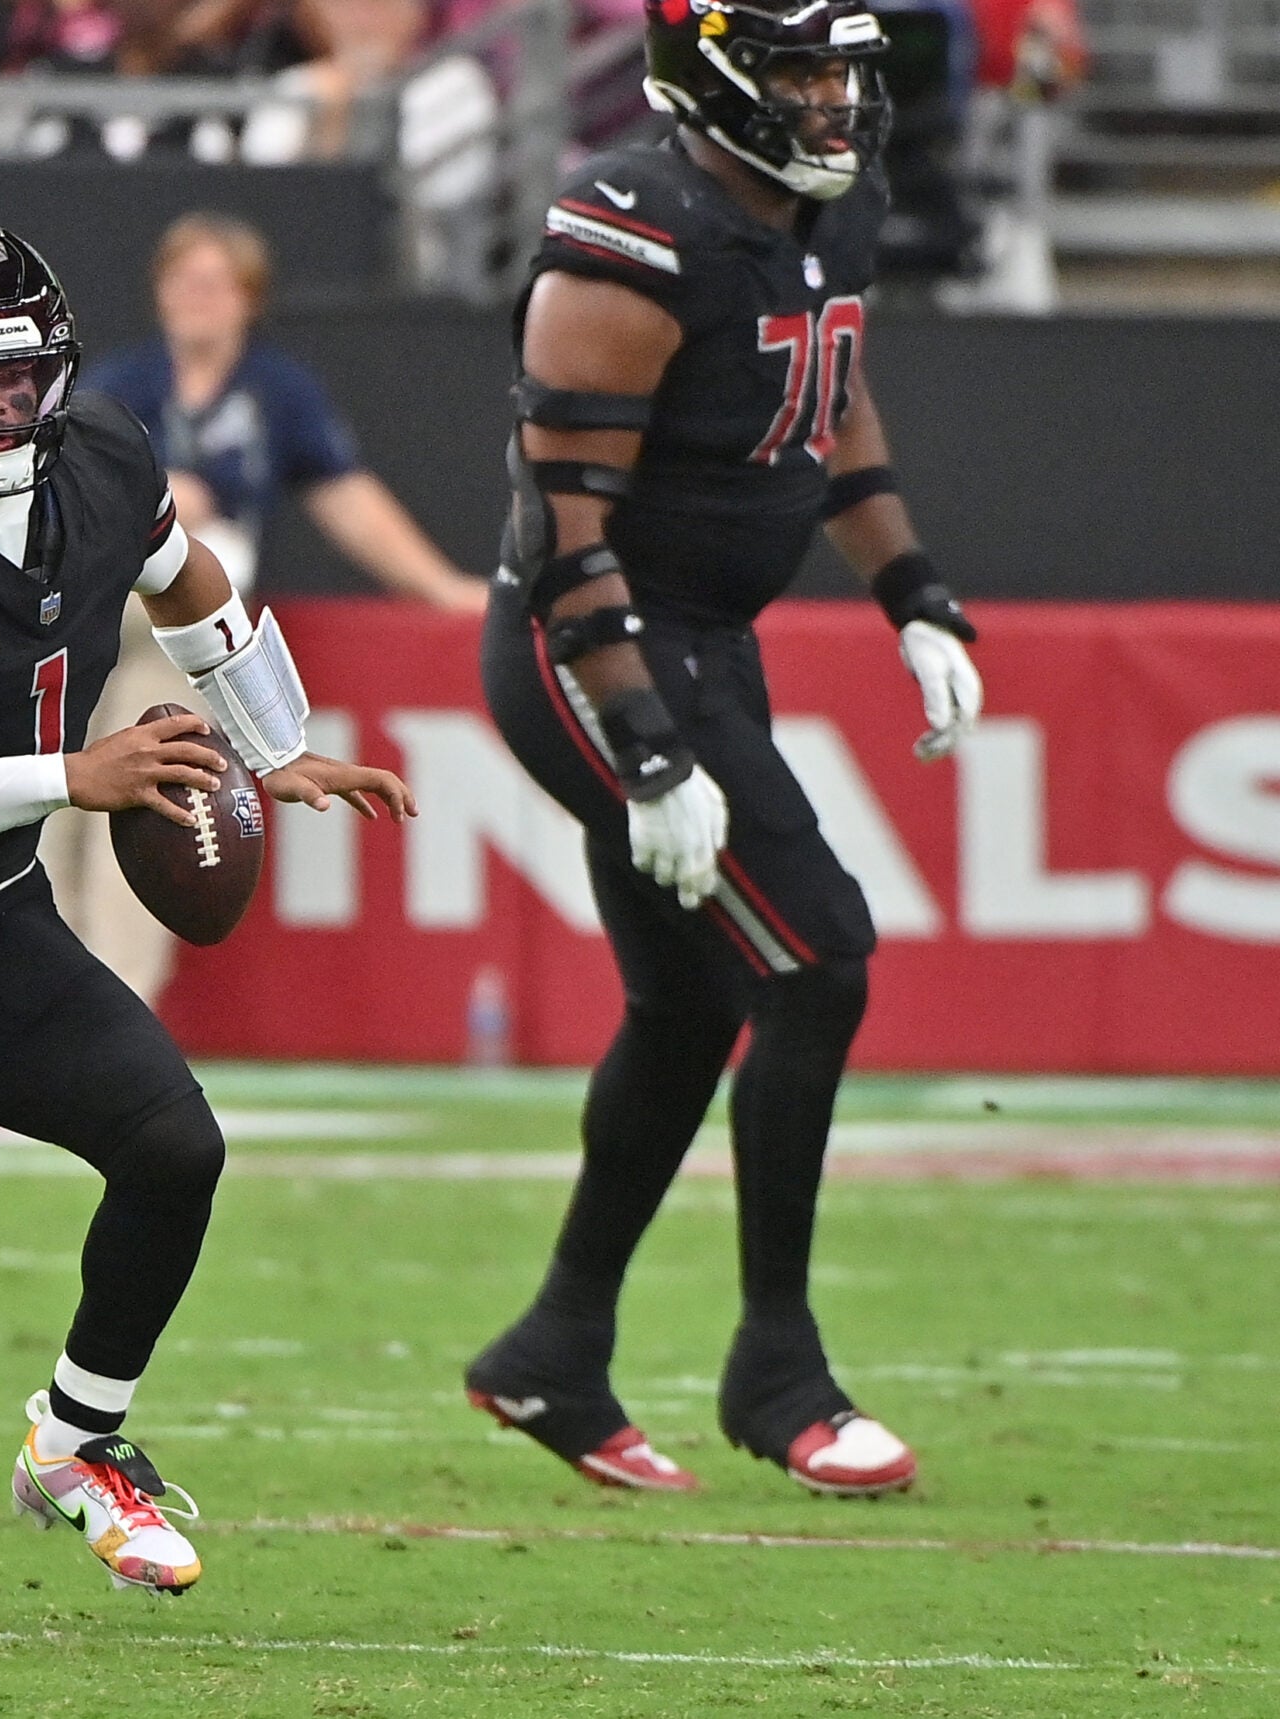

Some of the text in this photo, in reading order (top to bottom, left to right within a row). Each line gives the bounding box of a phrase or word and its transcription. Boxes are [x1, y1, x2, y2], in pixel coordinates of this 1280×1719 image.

[748, 296, 863, 466] 70
[214, 618, 236, 652] 1
[29, 646, 68, 755] 1
